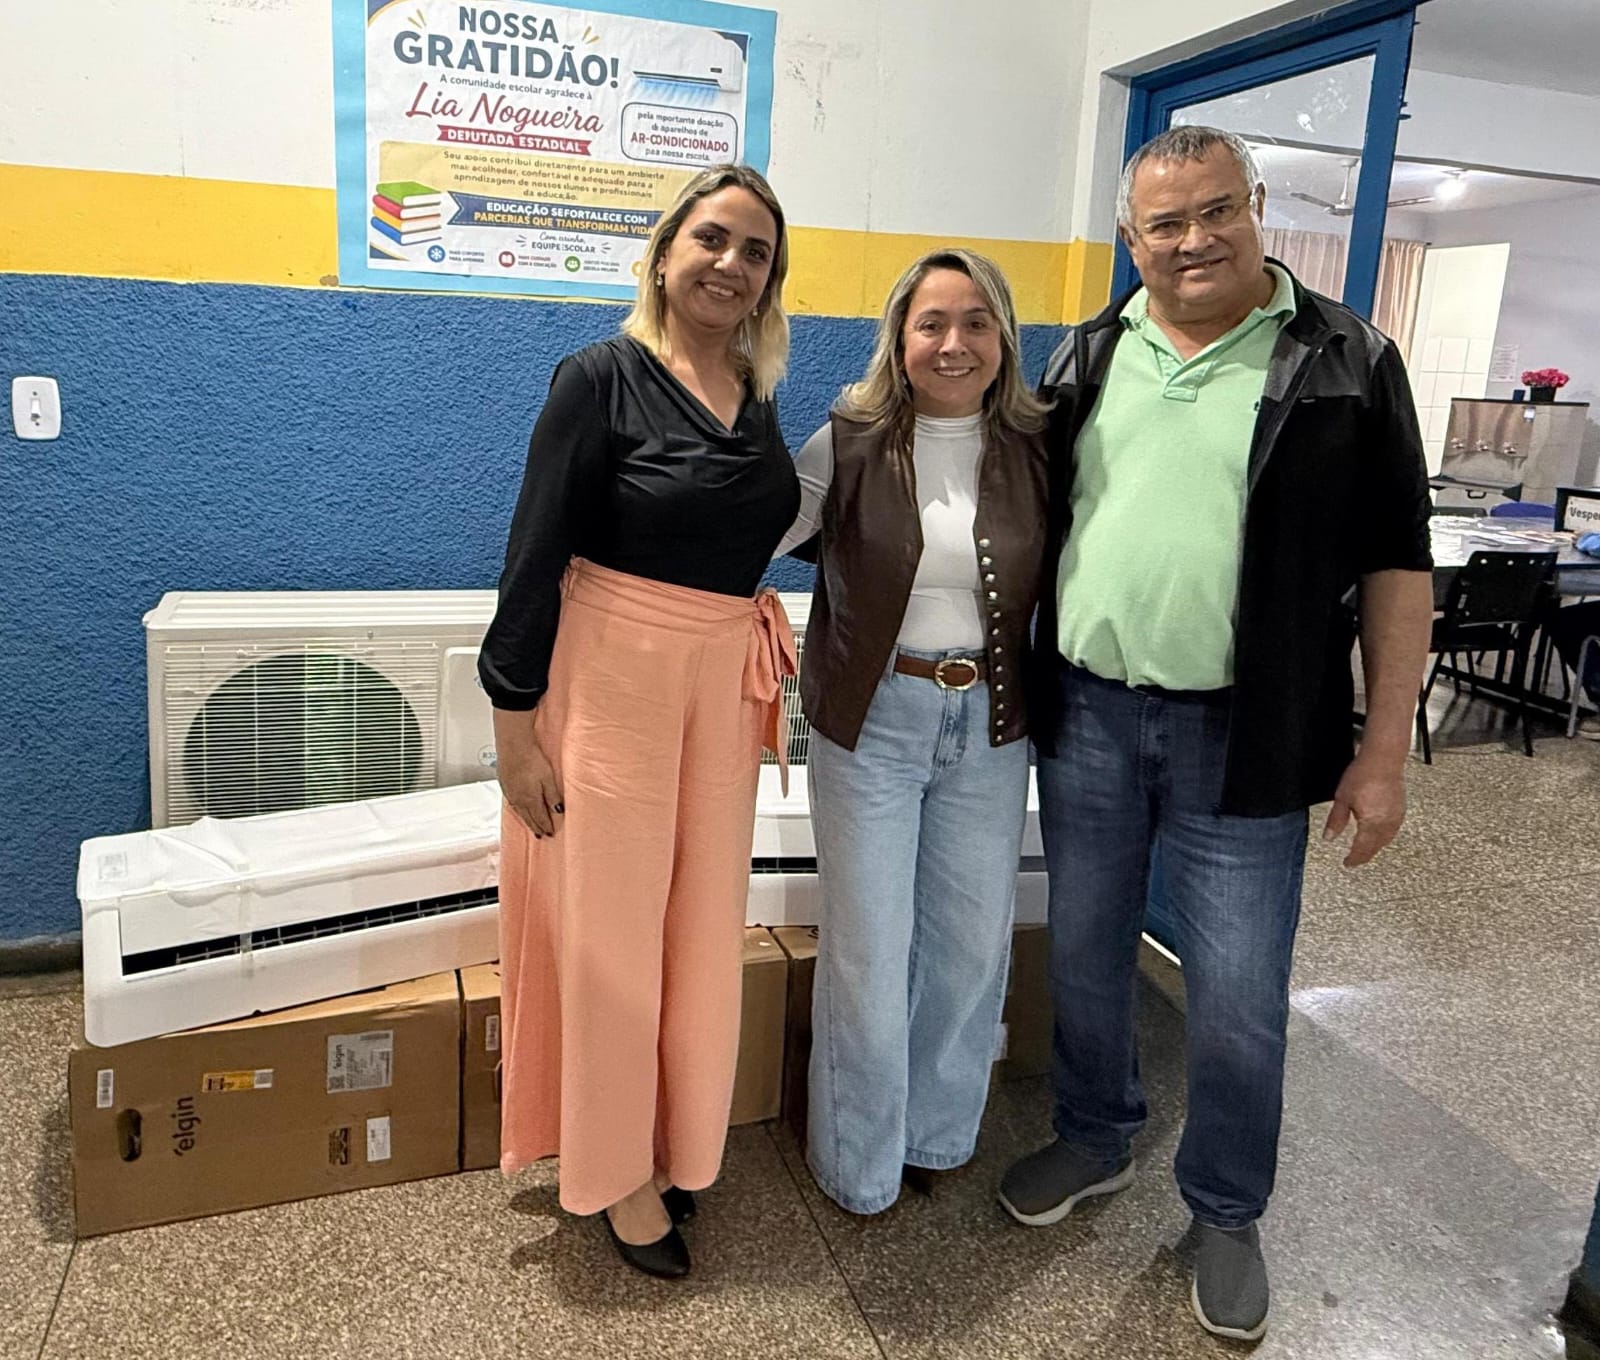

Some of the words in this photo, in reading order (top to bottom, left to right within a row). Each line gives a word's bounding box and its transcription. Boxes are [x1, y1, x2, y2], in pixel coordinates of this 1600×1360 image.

[459, 6, 559, 43] NOSSA
[393, 30, 619, 88] GRATIDÃO!
[440, 74, 447, 83] A
[450, 76, 506, 90] comunidade
[509, 83, 542, 95] escolar
[405, 82, 463, 118] Lia
[469, 93, 604, 133] Nogueira
[638, 112, 654, 121] pela
[630, 132, 729, 152] AR-CONDICIONADO
[699, 129, 708, 137] de
[444, 151, 461, 160] Seu
[490, 156, 531, 166] contribui
[589, 166, 608, 175] para
[662, 149, 683, 158] nossa
[518, 178, 529, 186] de
[532, 181, 561, 189] nossos
[600, 187, 652, 198] profissionais
[582, 175, 625, 185] adequado
[627, 180, 645, 188] para
[523, 189, 534, 197] da
[474, 212, 530, 225] PARCERIAS
[532, 217, 553, 227] QUE
[486, 202, 549, 216] EDUCAÇÃO
[624, 215, 647, 225] COM
[532, 241, 560, 251] EQUIPE
[172, 1096, 202, 1156] elgin
